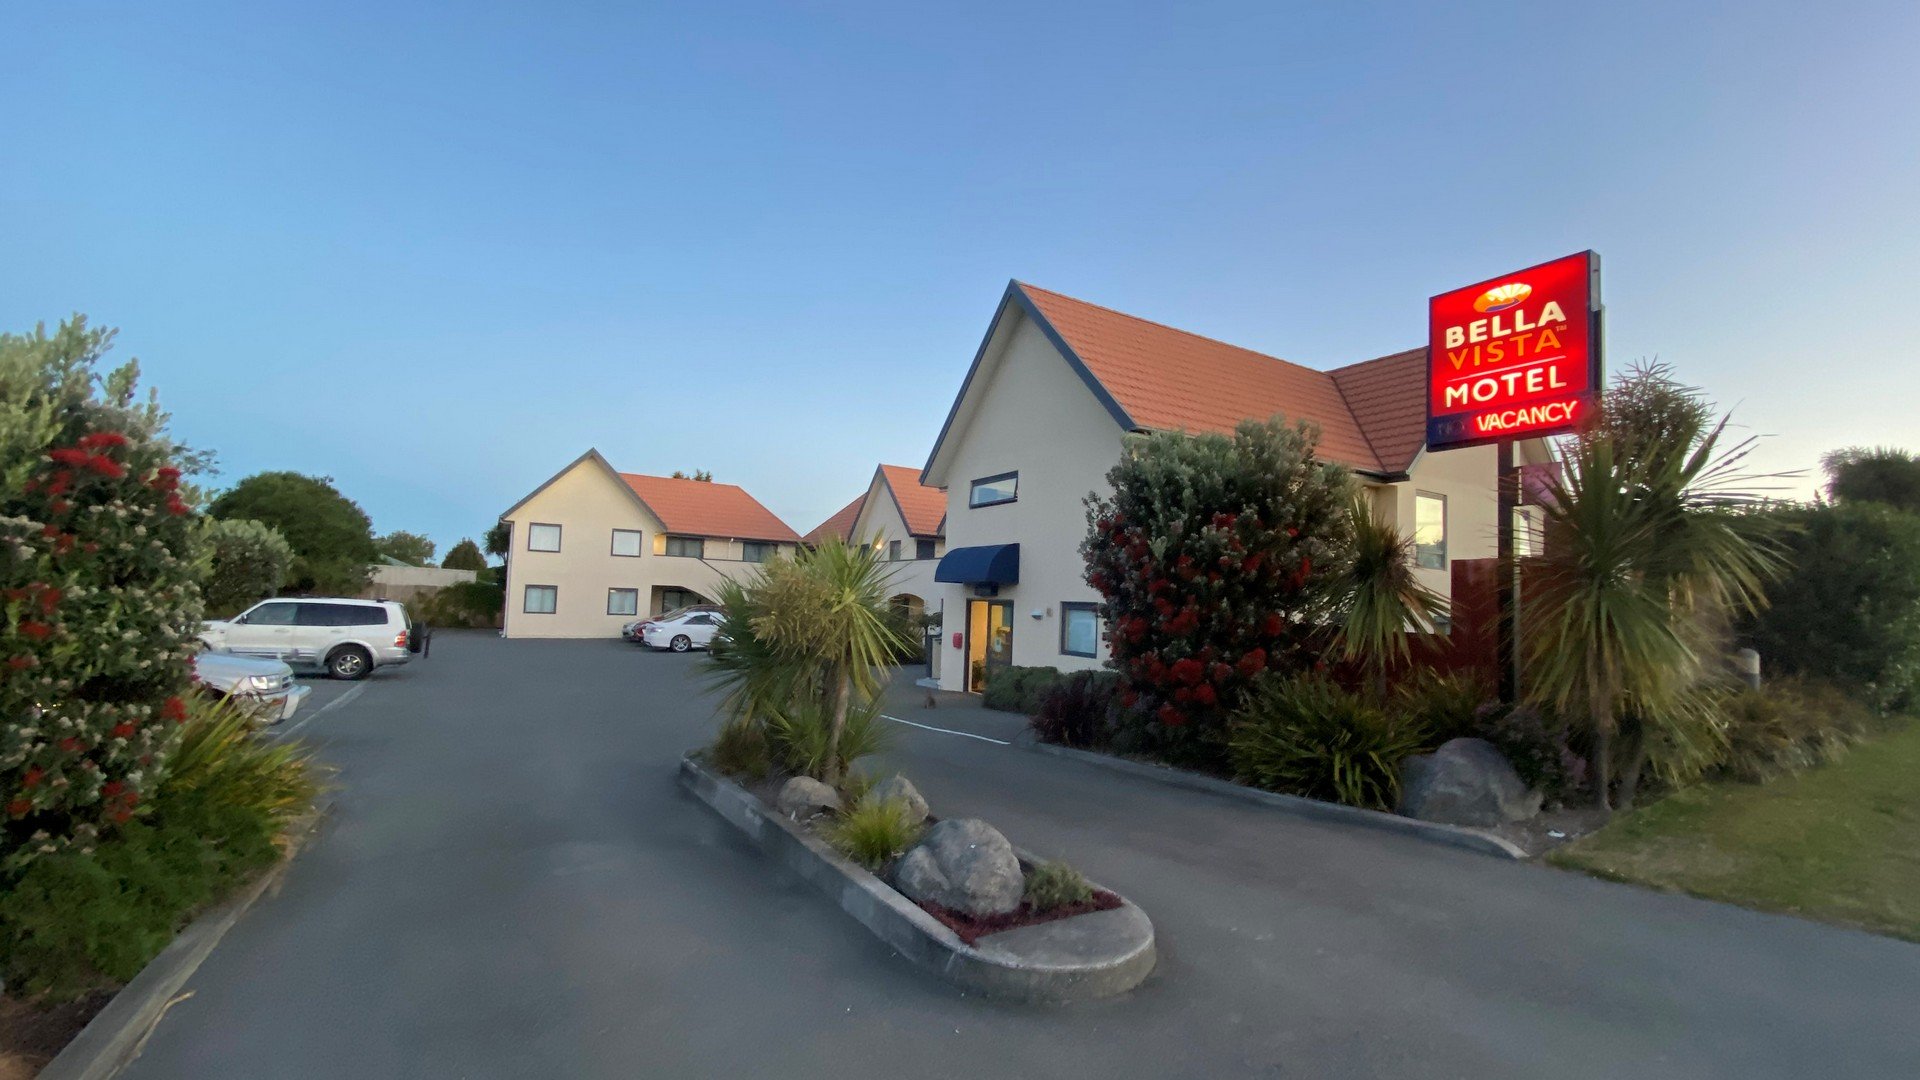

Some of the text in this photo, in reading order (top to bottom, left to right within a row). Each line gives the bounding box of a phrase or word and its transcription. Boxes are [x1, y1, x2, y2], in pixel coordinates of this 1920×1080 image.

[1446, 301, 1566, 349] BELLA
[1448, 328, 1562, 370] VISTA
[1445, 366, 1567, 408] MOTEL
[1477, 400, 1578, 431] VACANCY
